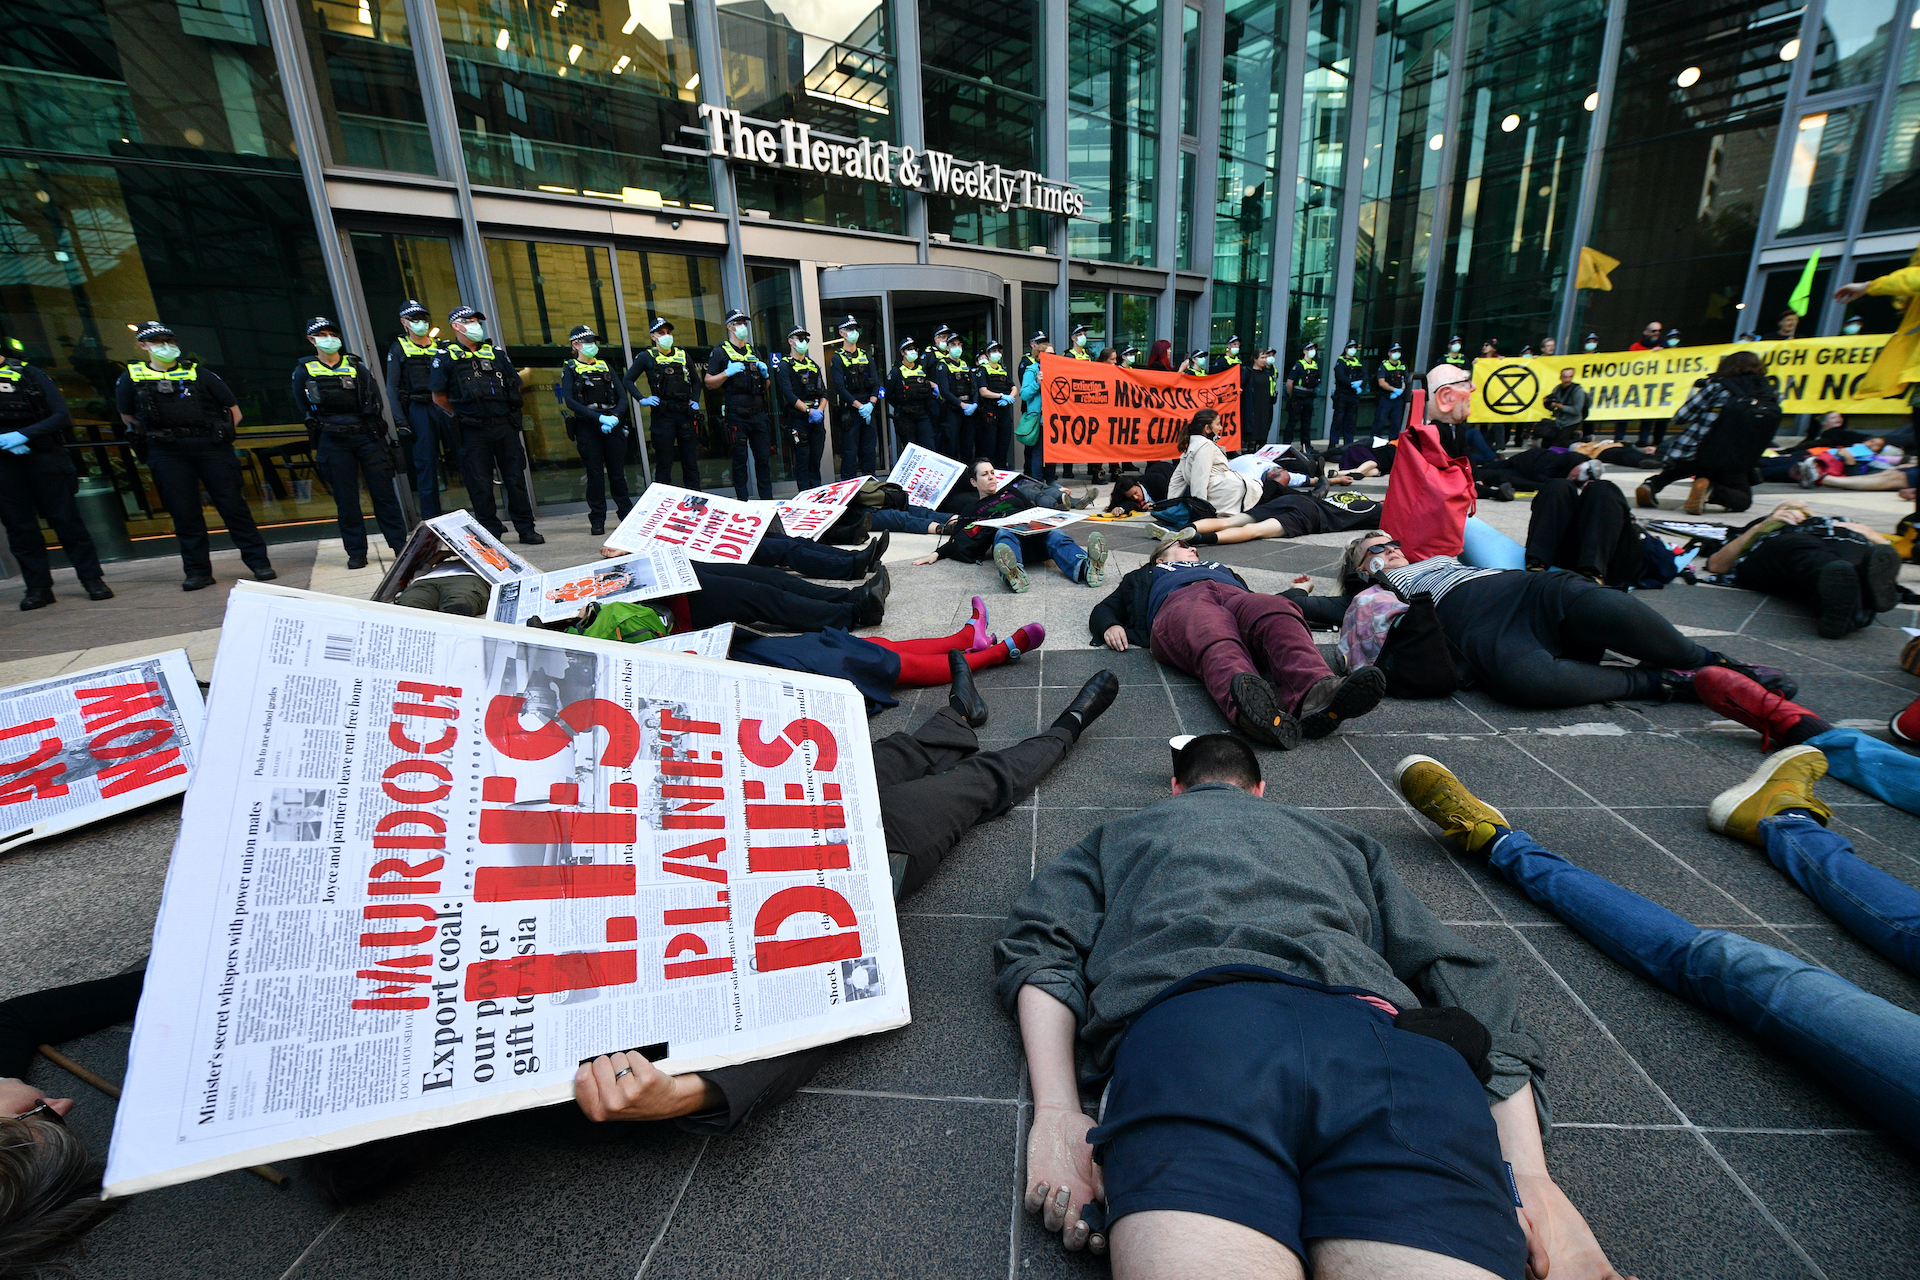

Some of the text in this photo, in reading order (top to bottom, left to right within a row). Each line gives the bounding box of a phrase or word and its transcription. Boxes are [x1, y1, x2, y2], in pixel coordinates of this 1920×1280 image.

[698, 103, 1085, 217] The Herald & Weekly Times
[1582, 359, 1659, 378] ENOUGH
[1666, 356, 1709, 374] LIES.
[1114, 379, 1199, 410] MURDOCH
[1050, 413, 1100, 445] STOP
[1108, 417, 1141, 445] THE
[1147, 417, 1189, 445] CLIM
[638, 497, 676, 537] MURDOCH
[653, 501, 709, 546] LIES
[690, 508, 729, 552] PLANET
[783, 508, 808, 530] LANET
[791, 509, 833, 531] DIES
[710, 513, 762, 560] DIES
[347, 678, 363, 707] home
[796, 688, 808, 724] scandal
[74, 681, 188, 799] NOW
[254, 686, 279, 776] Push to axe school grades
[342, 709, 359, 755] rent-free
[798, 725, 810, 752] fraud
[337, 757, 353, 785] leave
[620, 659, 635, 882] Qantas grounds A380s after engine blast
[738, 769, 746, 777] in
[803, 753, 812, 766] on
[337, 788, 349, 798] to
[804, 767, 816, 803] silence
[248, 801, 262, 836] mates
[331, 801, 348, 843] partner
[809, 805, 820, 839] breaks
[240, 838, 256, 874] union
[351, 680, 463, 1010] MURDOCH
[463, 694, 641, 1002] LIES
[660, 708, 734, 980] PLANET
[738, 718, 863, 972] DIES
[743, 828, 753, 849] dollar
[328, 846, 341, 868] and
[813, 841, 826, 889] detective
[234, 876, 251, 915] power
[322, 869, 340, 904] Joyce
[228, 918, 244, 947] with
[725, 918, 735, 934] risk
[727, 935, 738, 964] grants
[217, 949, 240, 1007] whispers
[505, 916, 540, 1075] gift to Asia
[729, 966, 739, 990] solar
[827, 968, 840, 1006] Shock
[421, 901, 464, 1094] Export coal:
[472, 925, 504, 1083] our power
[732, 992, 743, 1032] Popular
[214, 1010, 231, 1050] secret
[400, 1066, 411, 1100] LOCAL
